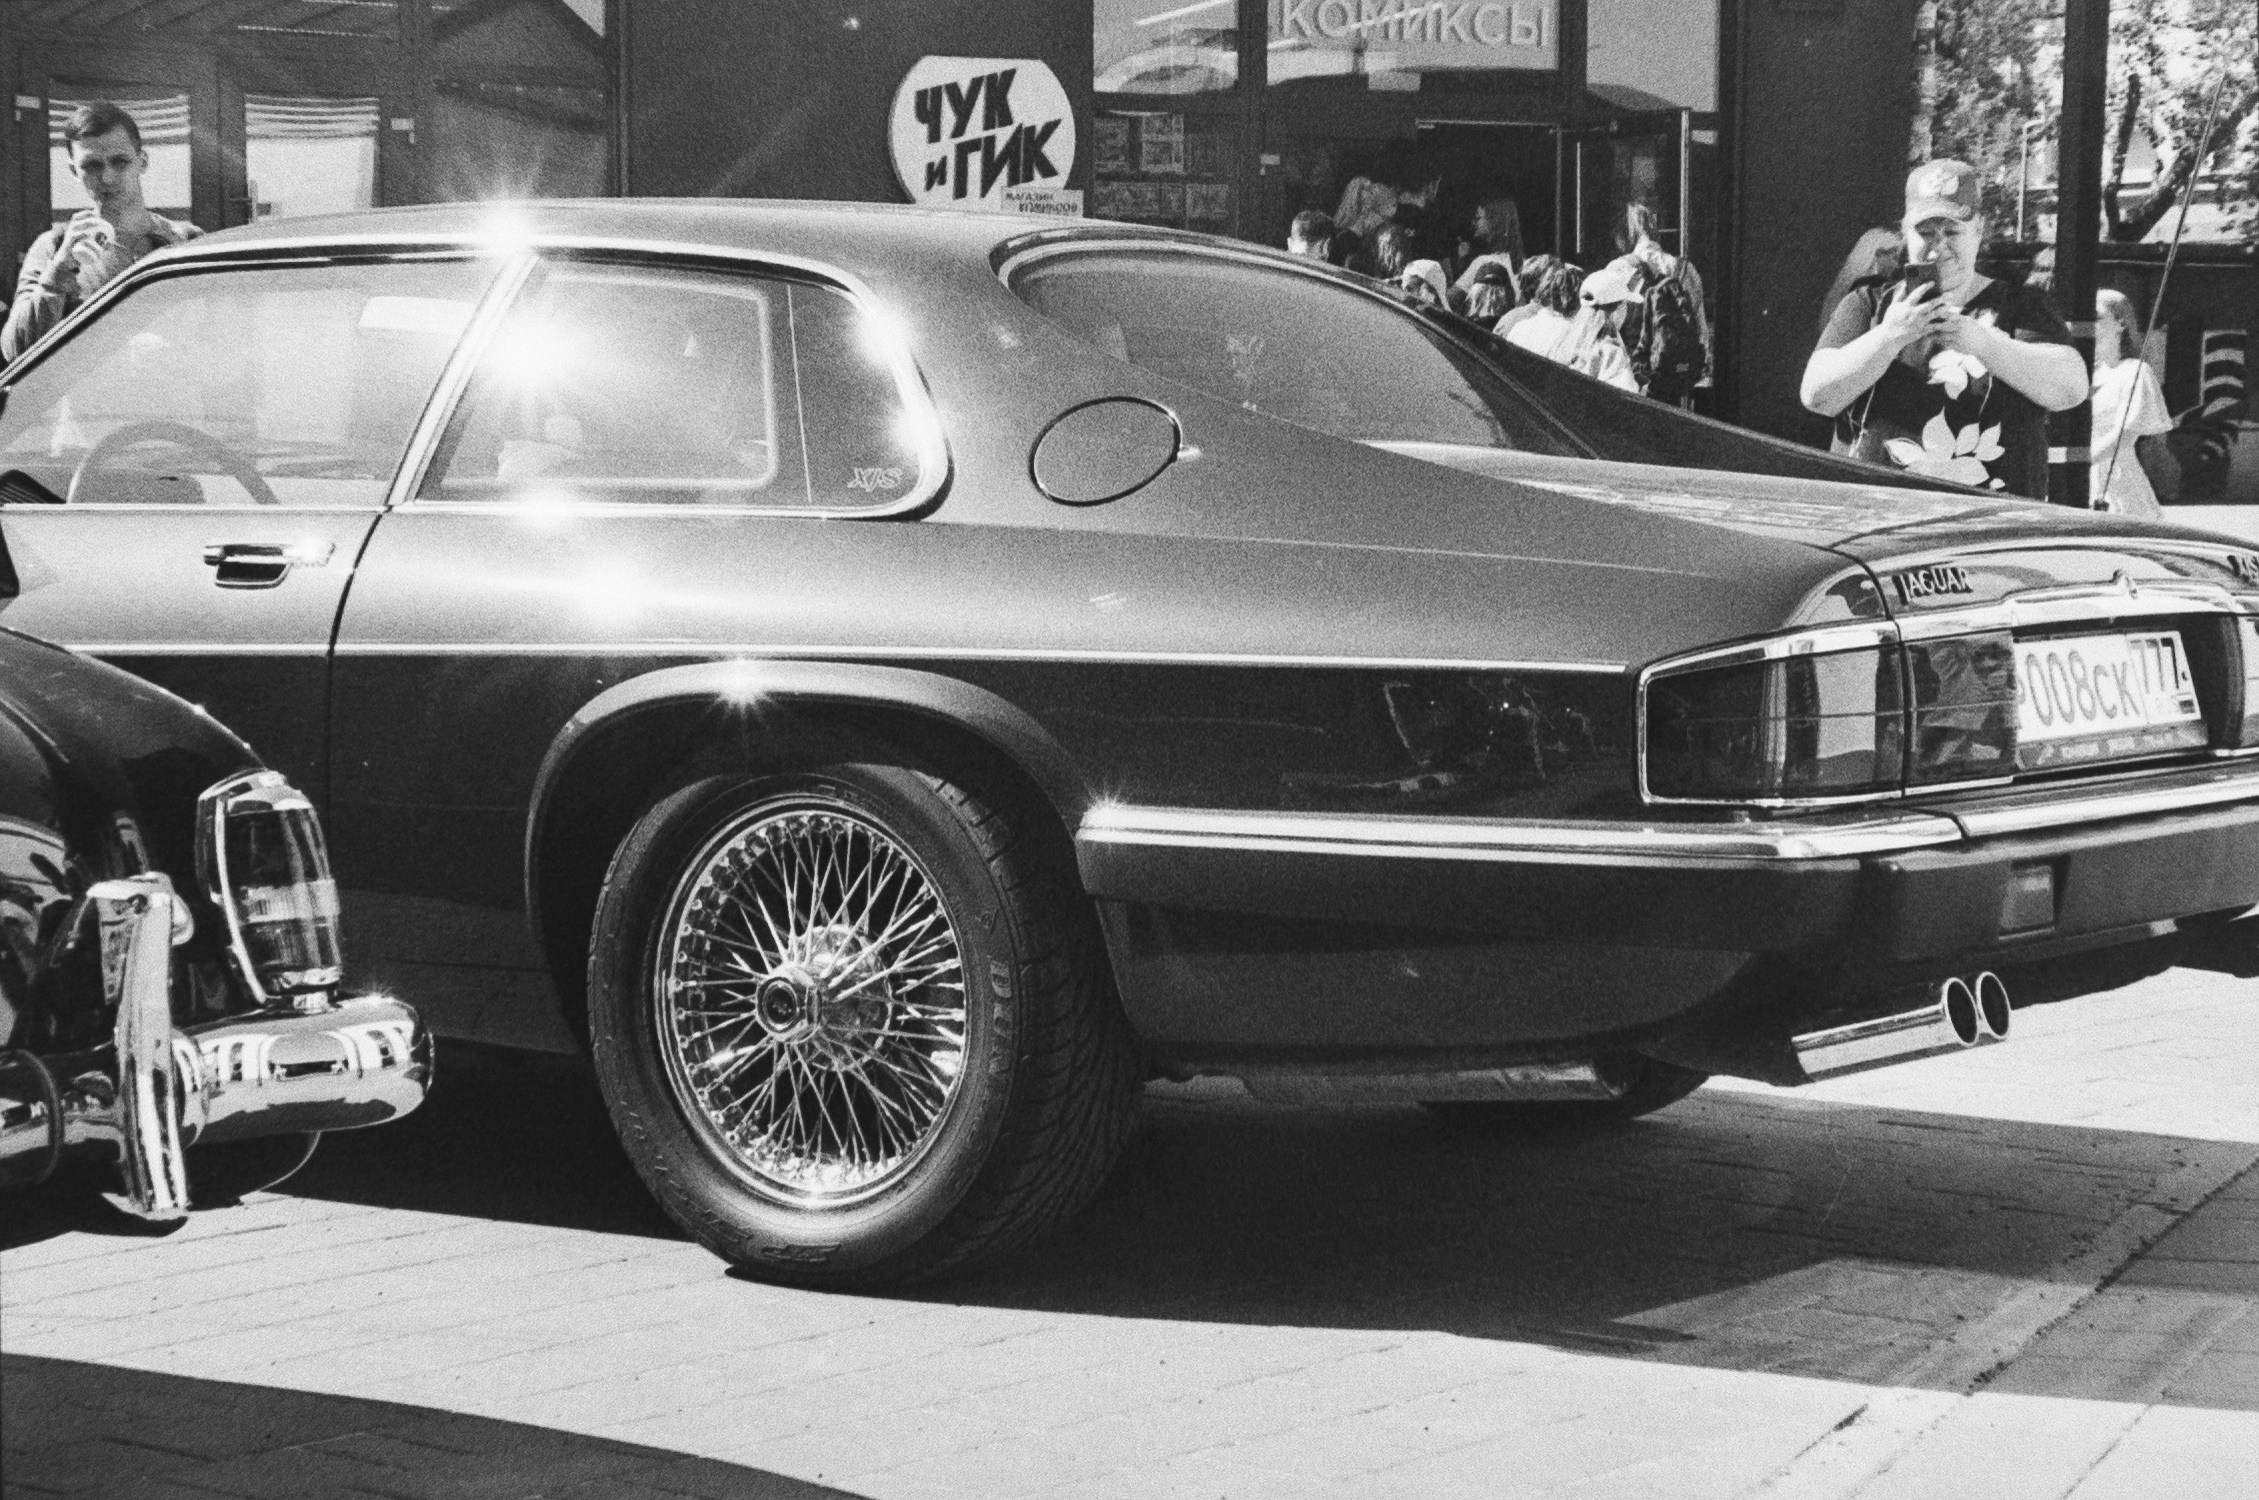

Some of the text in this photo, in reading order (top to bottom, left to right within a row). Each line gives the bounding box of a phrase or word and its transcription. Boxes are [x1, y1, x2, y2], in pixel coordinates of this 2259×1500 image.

[1284, 0, 1552, 47] КОМИКСЫ
[915, 68, 1017, 144] ЧУК
[952, 118, 1062, 199] ГИК
[1893, 567, 1974, 605] JAGUAR
